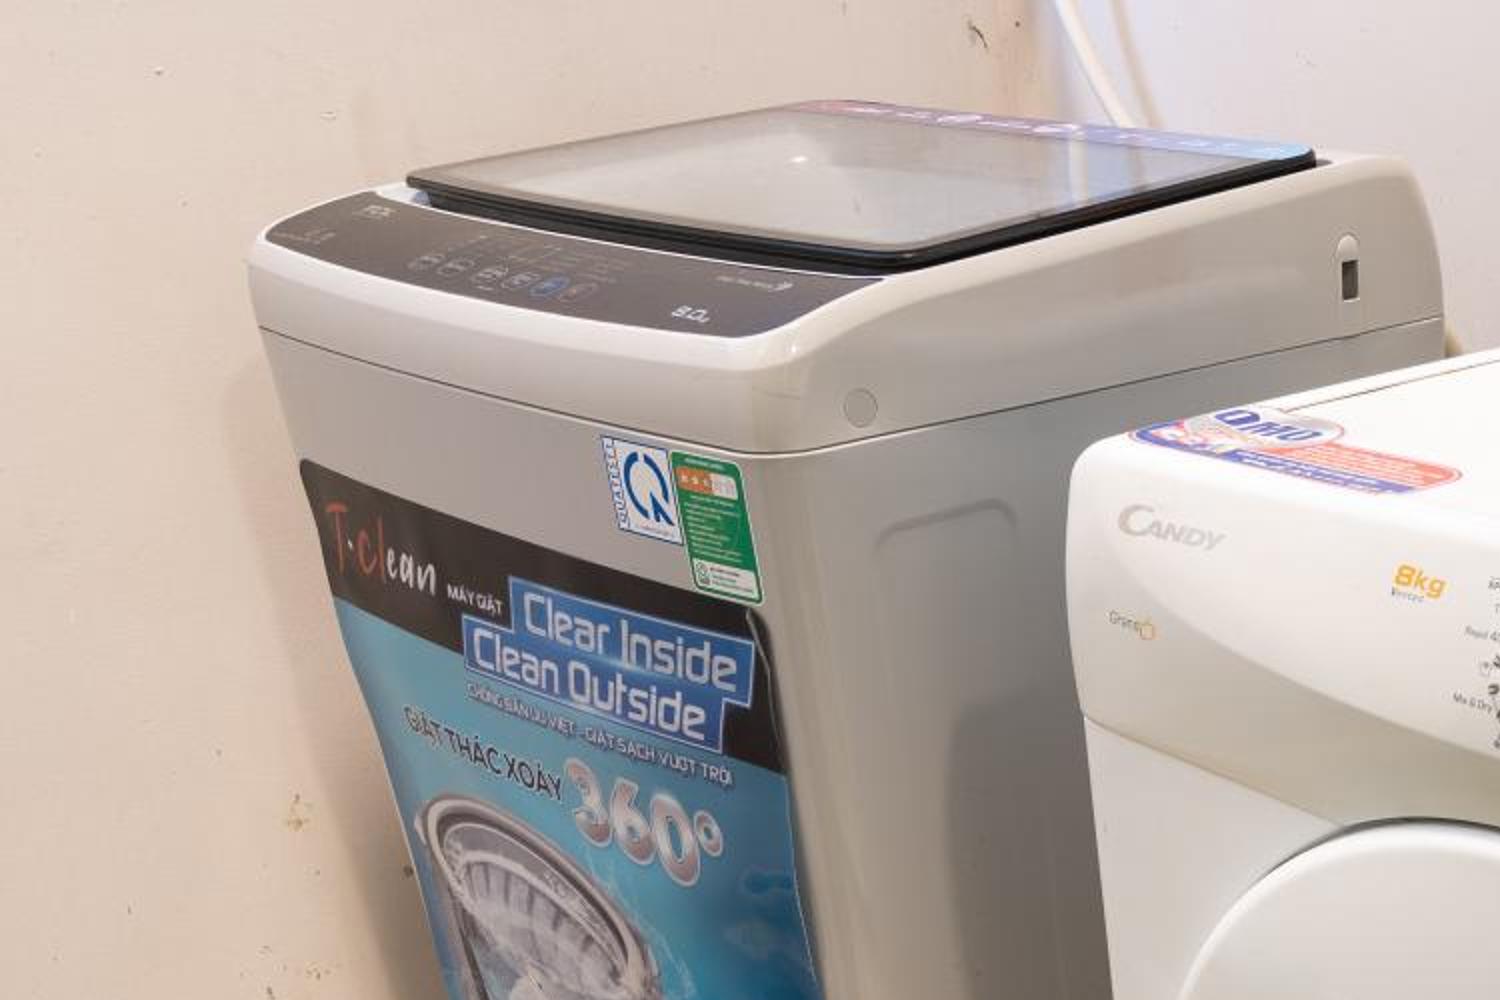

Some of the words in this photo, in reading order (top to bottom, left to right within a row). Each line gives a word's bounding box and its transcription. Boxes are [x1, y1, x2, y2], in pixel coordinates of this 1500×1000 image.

[1118, 503, 1226, 551] CANDY
[1395, 564, 1446, 599] 8kg
[523, 590, 610, 655] Clear
[620, 617, 737, 692] Inside
[473, 627, 560, 696] Clean
[567, 660, 705, 741] Outside
